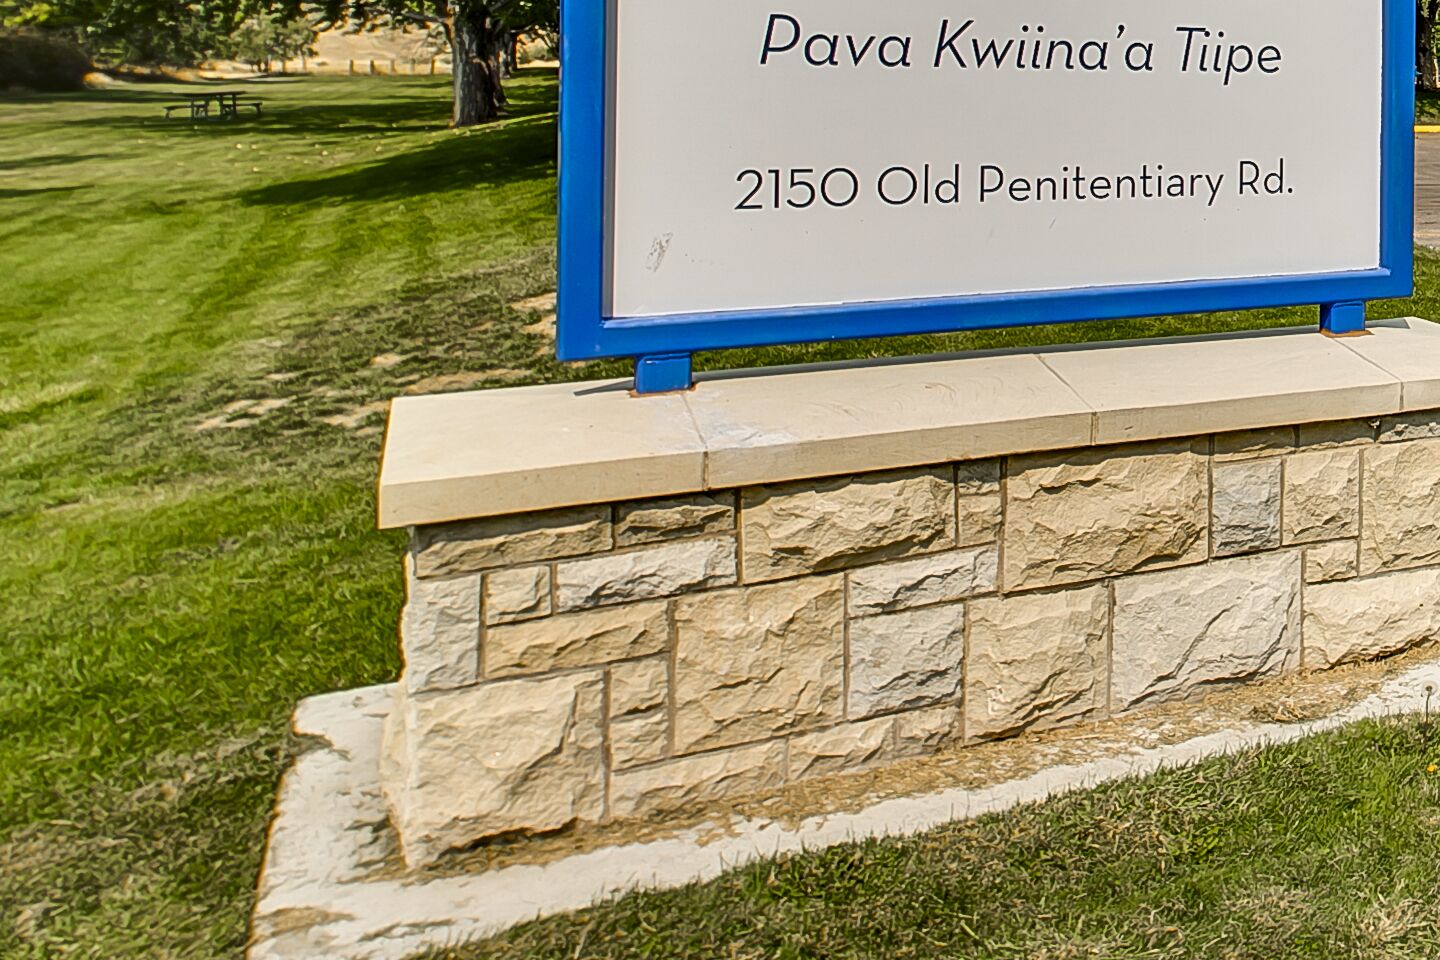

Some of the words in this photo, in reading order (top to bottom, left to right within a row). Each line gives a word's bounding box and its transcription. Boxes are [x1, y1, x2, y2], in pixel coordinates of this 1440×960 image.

[759, 13, 912, 68] Pava
[1175, 26, 1282, 86] Tiipe
[734, 167, 859, 210] 2150
[877, 163, 960, 206] Old
[979, 164, 1225, 207] Penitentiary
[1239, 157, 1293, 195] Rd.
